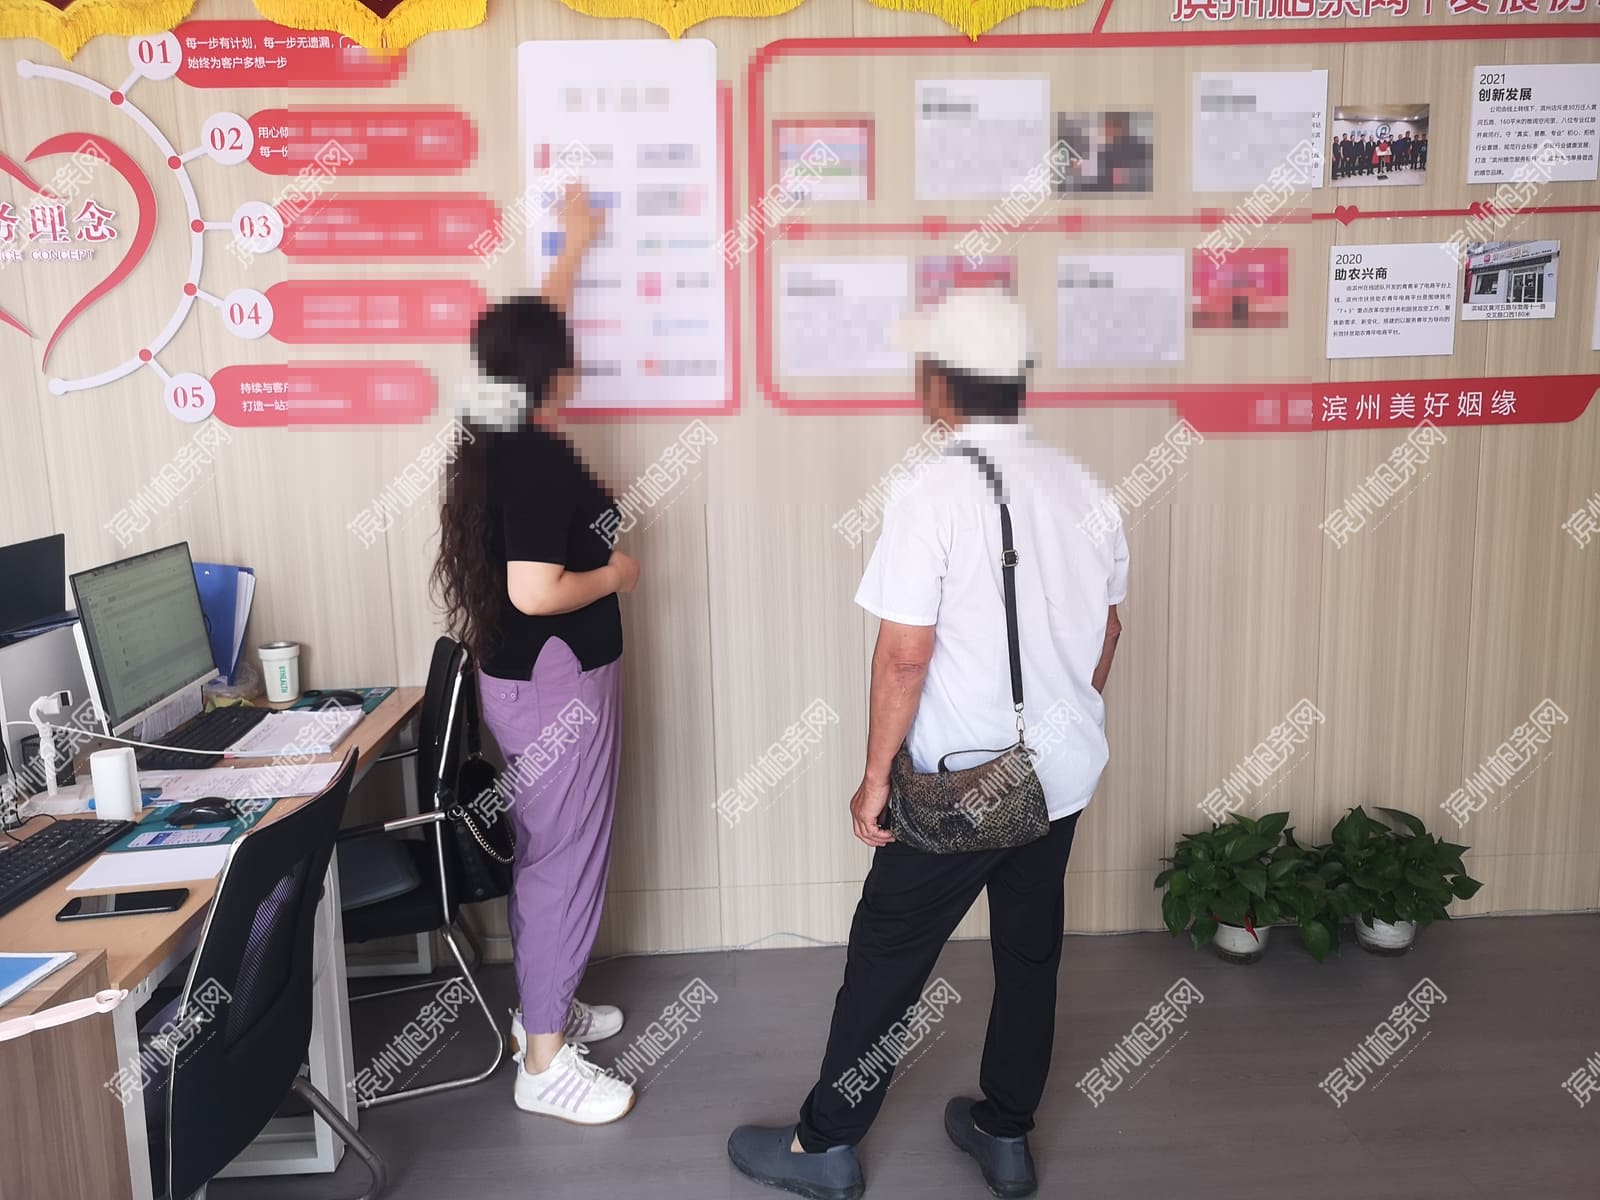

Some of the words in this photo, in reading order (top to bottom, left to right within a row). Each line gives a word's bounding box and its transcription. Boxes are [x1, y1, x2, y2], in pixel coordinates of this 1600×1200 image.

[138, 39, 172, 65] 01
[187, 56, 288, 70] 始终为客户多想一步
[1479, 73, 1506, 85] 2021
[1478, 87, 1532, 102] 创新发展
[210, 127, 243, 151] 02
[239, 215, 271, 239] 03
[31, 248, 96, 261] CONCEPT
[1335, 254, 1363, 265] 2020
[1334, 267, 1388, 281] 助农兴商
[229, 303, 262, 326] 04
[173, 386, 206, 409] 05
[1322, 389, 1518, 422] 滨州美好姻缘
